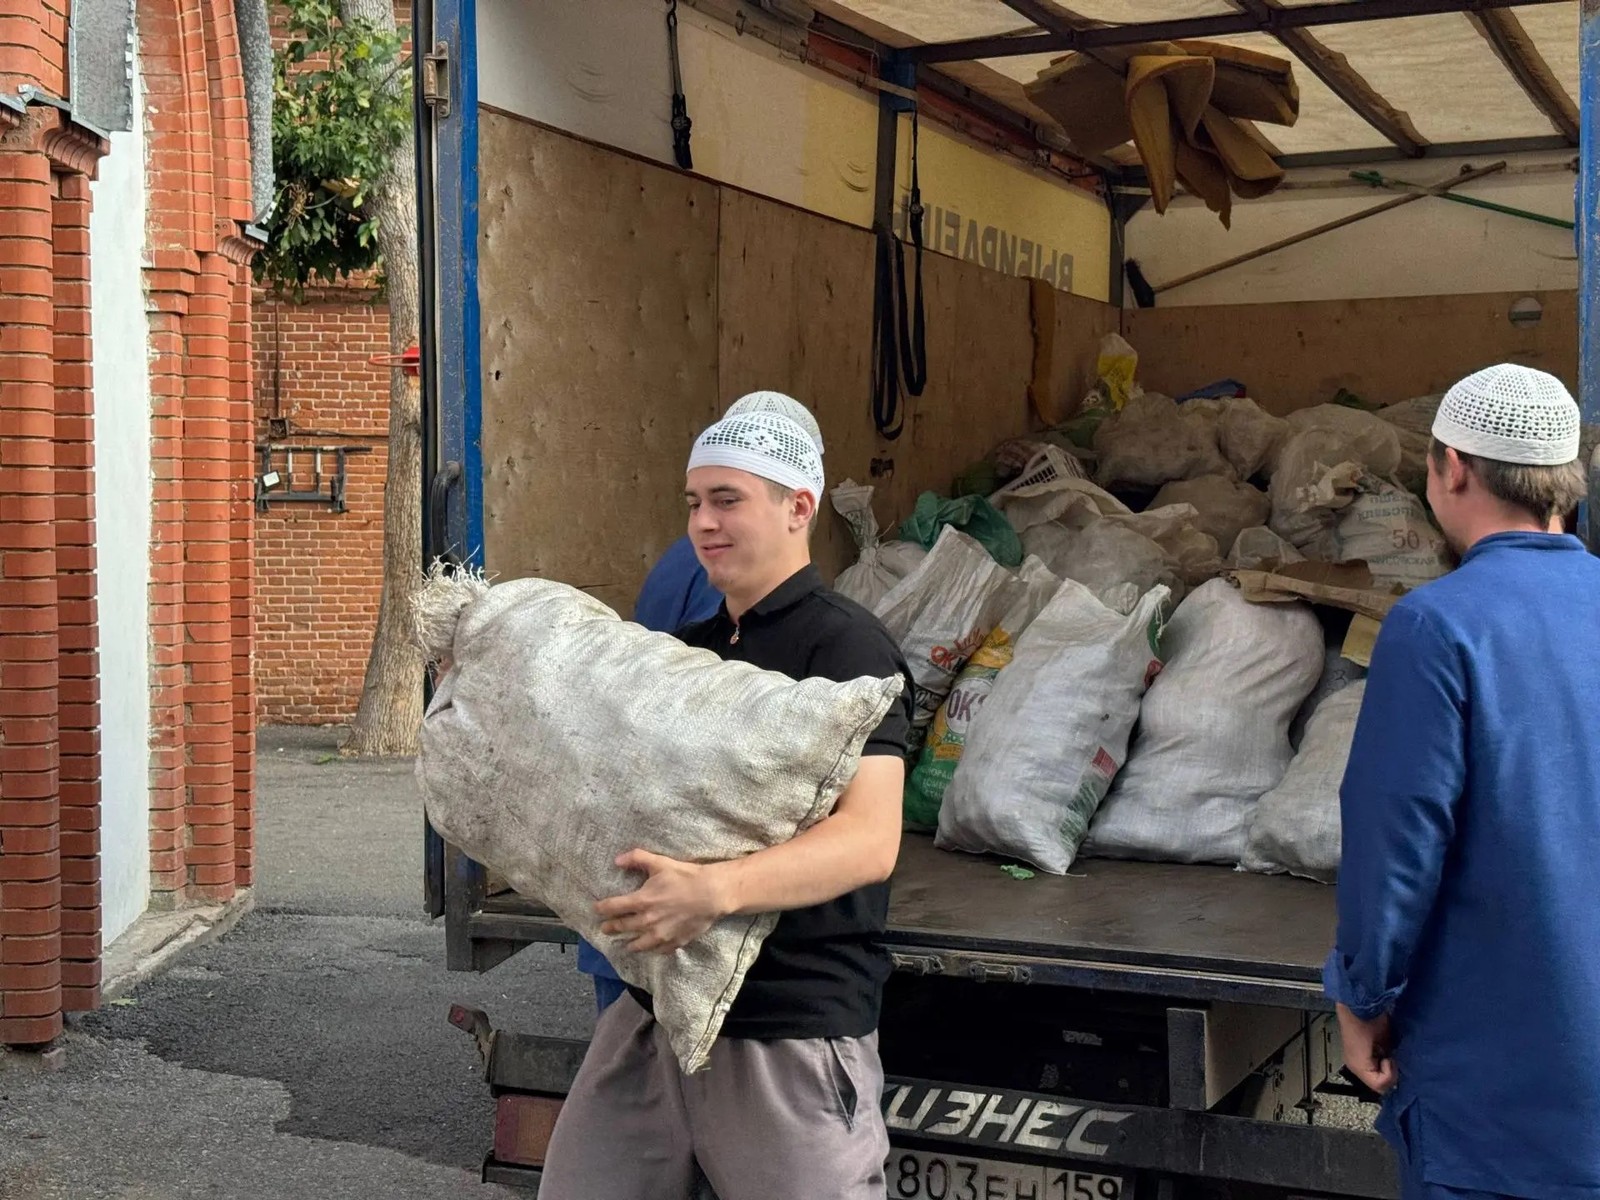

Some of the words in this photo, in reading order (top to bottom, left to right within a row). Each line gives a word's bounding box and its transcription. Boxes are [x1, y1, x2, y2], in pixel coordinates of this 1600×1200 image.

[1392, 528, 1419, 550] 50
[884, 1083, 1135, 1155] ИЗНЕС
[884, 1154, 1039, 1200] 803ЕН
[1052, 1171, 1119, 1200] 159
